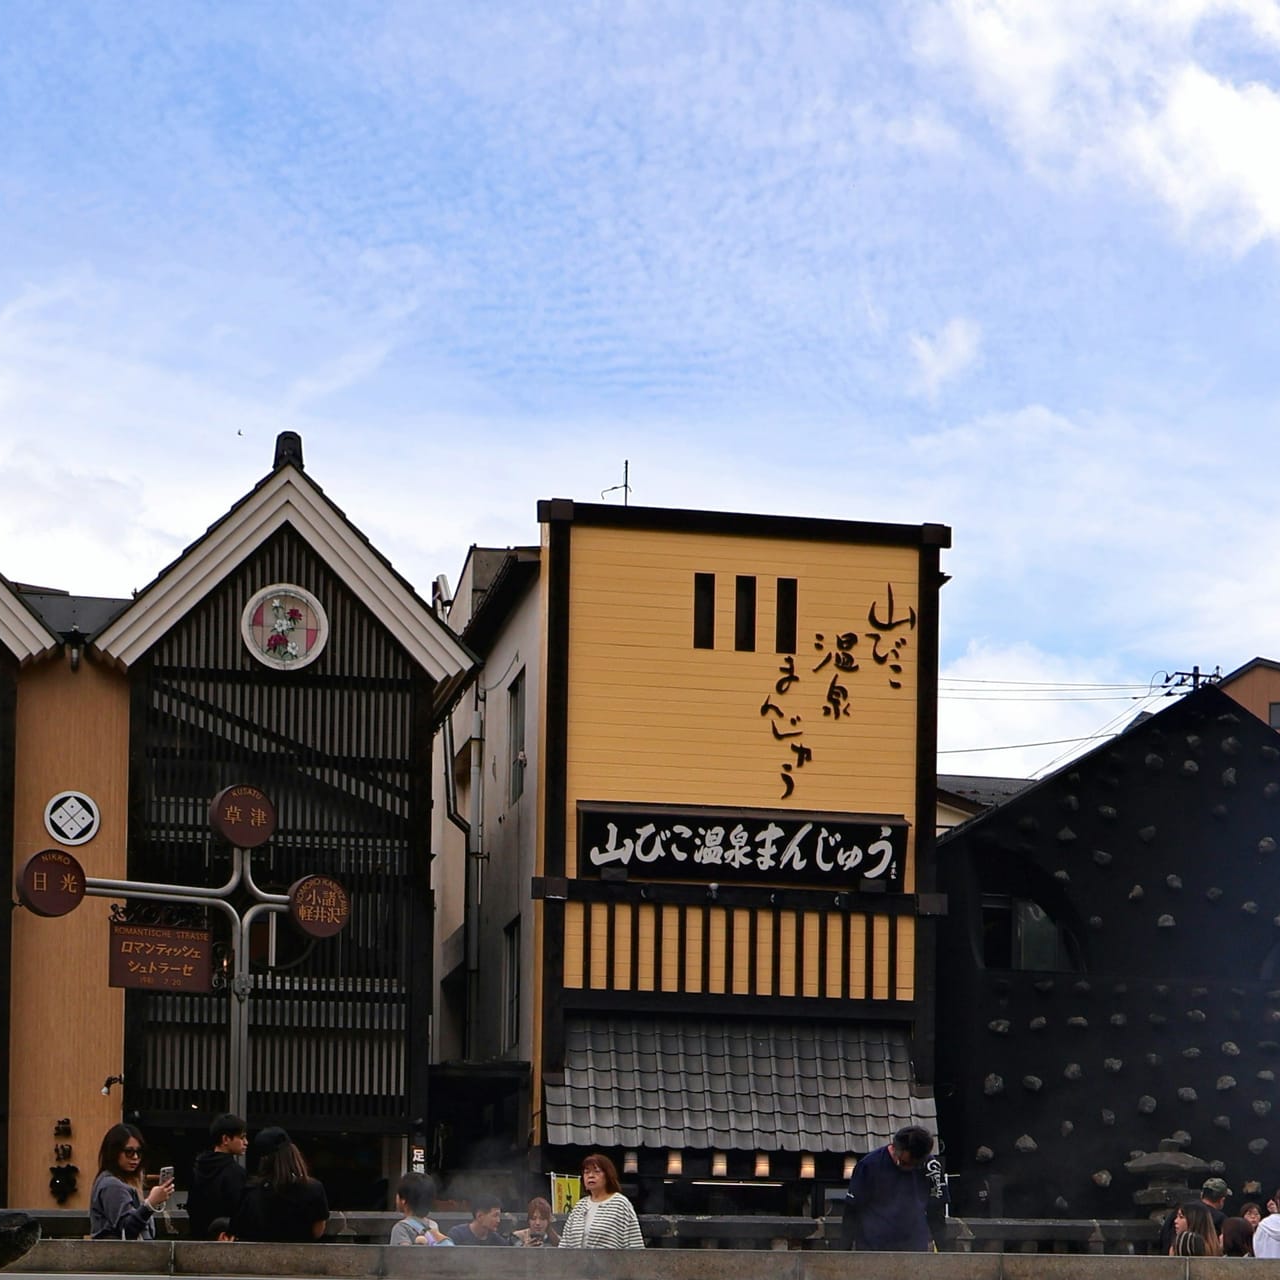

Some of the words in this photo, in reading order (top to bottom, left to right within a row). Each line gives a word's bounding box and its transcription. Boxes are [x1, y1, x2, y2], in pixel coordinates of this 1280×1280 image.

[866, 582, 916, 689] 山びこ
[813, 632, 860, 720] 温泉
[224, 805, 267, 827] 草津
[41, 853, 71, 865] NIKKO
[589, 822, 893, 880] 山びこ温泉まんじゅう
[33, 871, 78, 893] 日光
[306, 889, 336, 907] 小諸
[299, 904, 341, 924] 軽井沢
